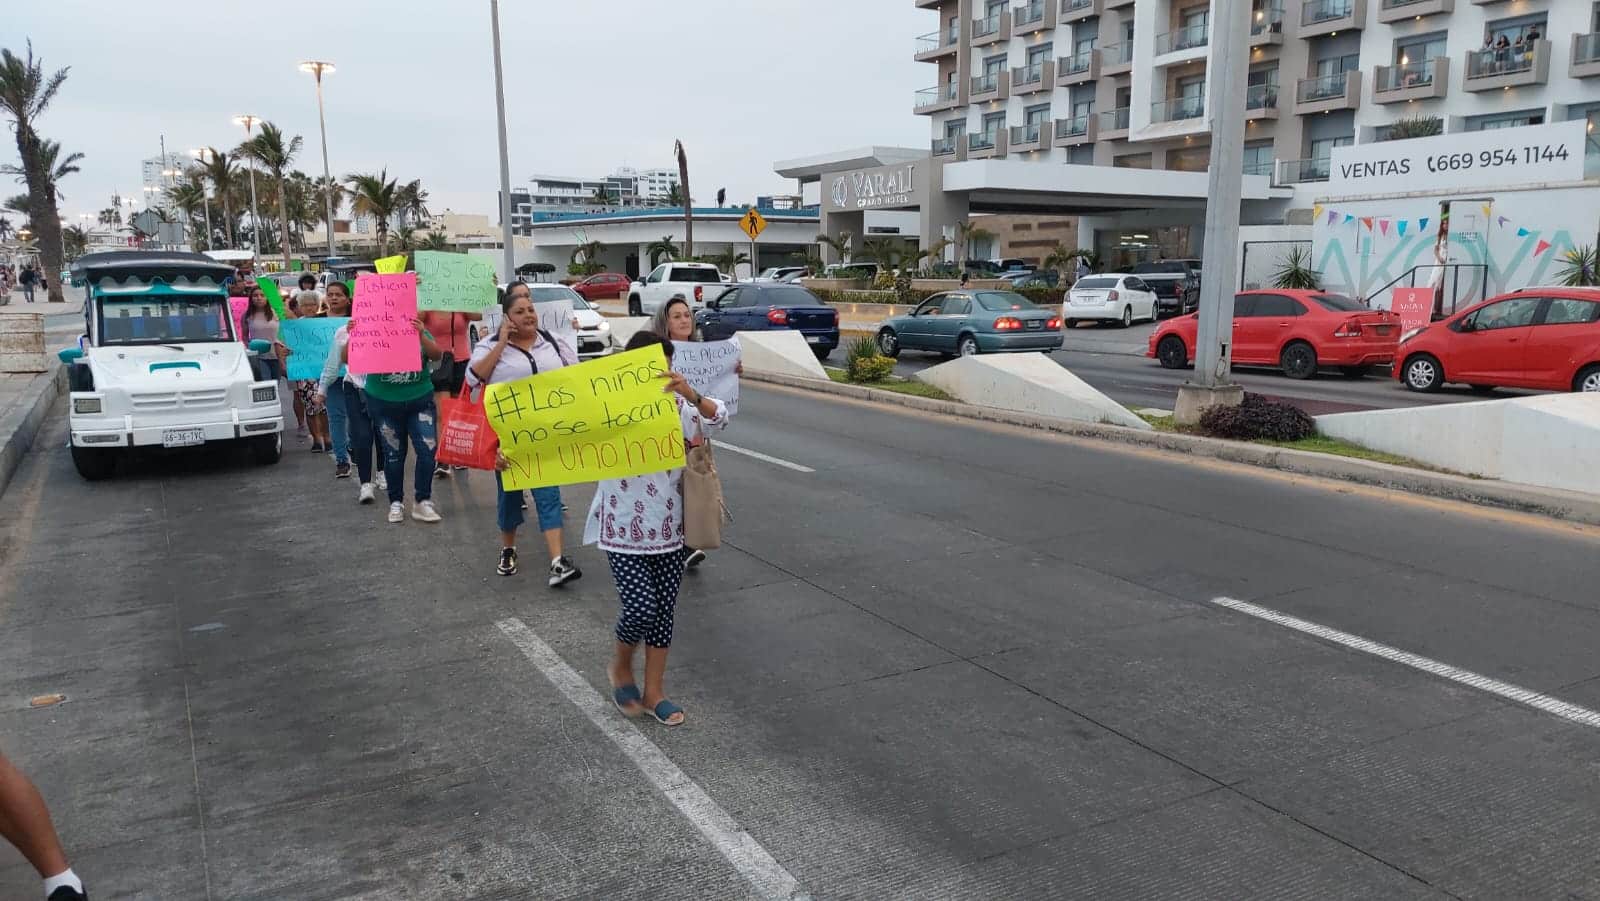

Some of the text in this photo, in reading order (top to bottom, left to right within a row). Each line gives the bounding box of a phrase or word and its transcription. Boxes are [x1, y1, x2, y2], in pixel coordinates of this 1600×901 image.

[851, 165, 914, 196] VARALI
[1341, 144, 1569, 179] VENTAS 669 954 1144
[857, 194, 910, 208] GRAND HOTEL
[1316, 229, 1577, 312] AKOYA
[490, 360, 666, 423] #Los niños
[512, 398, 675, 445] no se tocan
